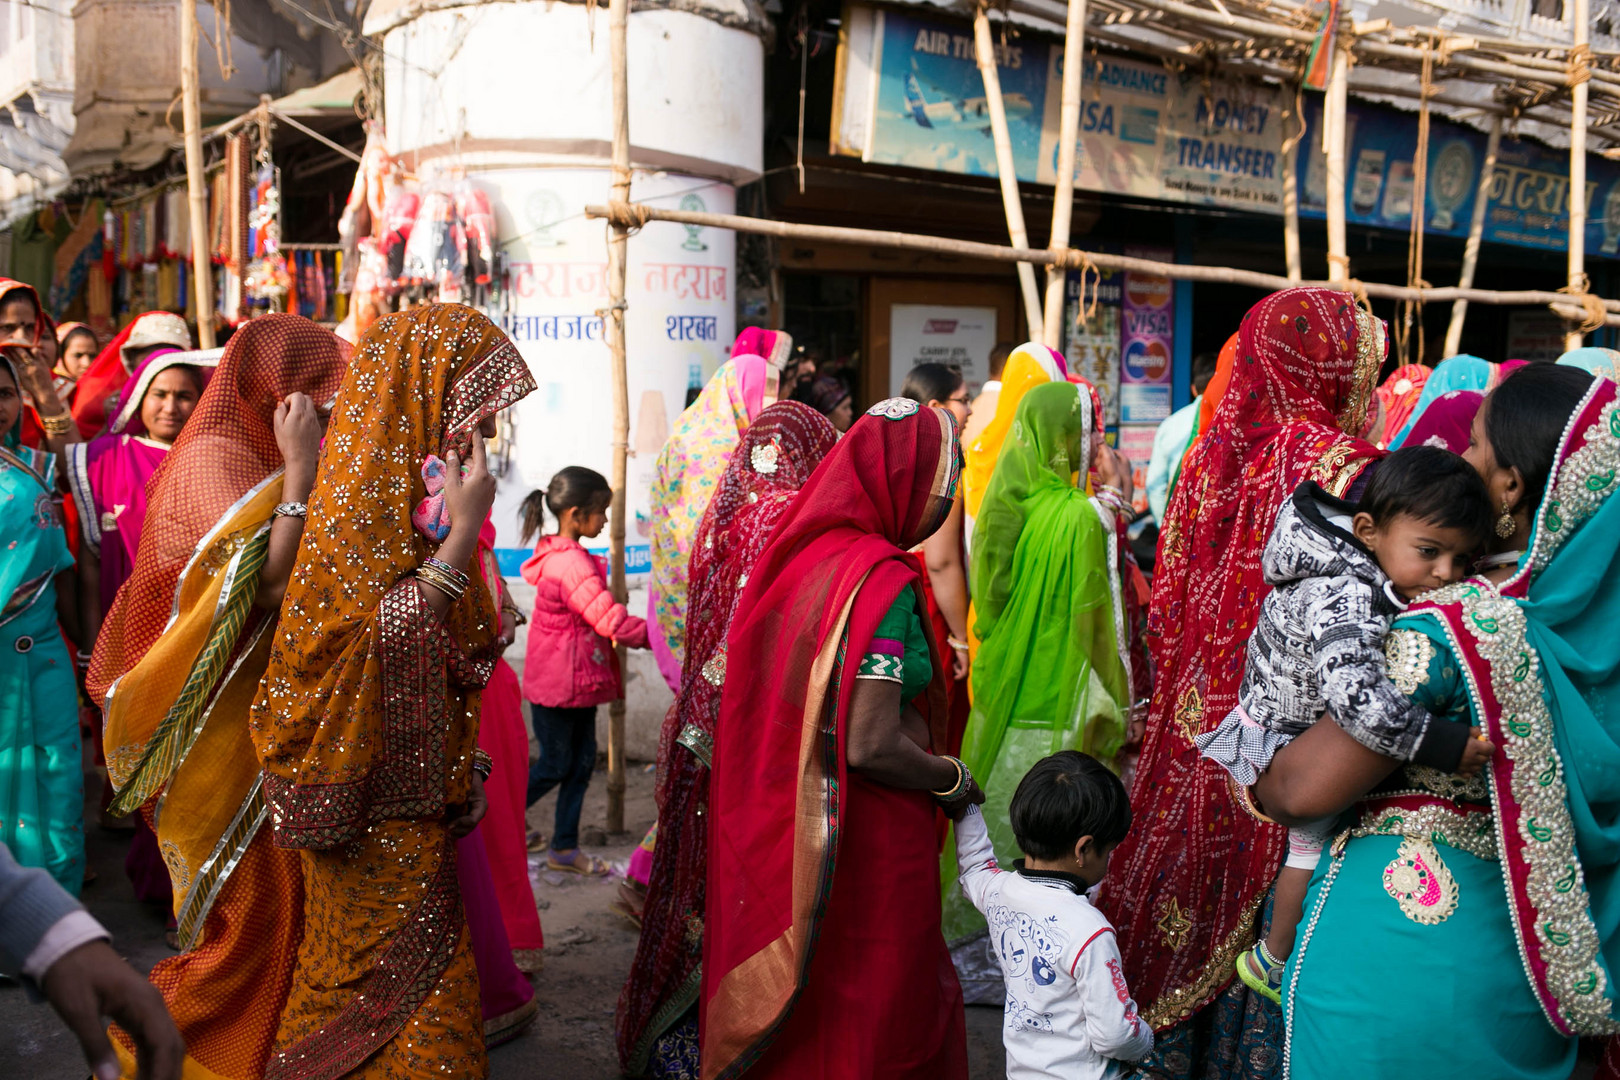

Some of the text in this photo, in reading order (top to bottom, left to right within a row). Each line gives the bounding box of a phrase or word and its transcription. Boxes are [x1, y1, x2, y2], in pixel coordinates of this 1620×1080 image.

[914, 29, 949, 56] AIR
[1100, 62, 1167, 95] ADVANCE
[1178, 137, 1276, 179] TRANSFER
[642, 262, 728, 302] नटराज
[666, 315, 718, 341] शरबत
[1127, 311, 1170, 335] VISA
[1129, 353, 1166, 368] Maestro
